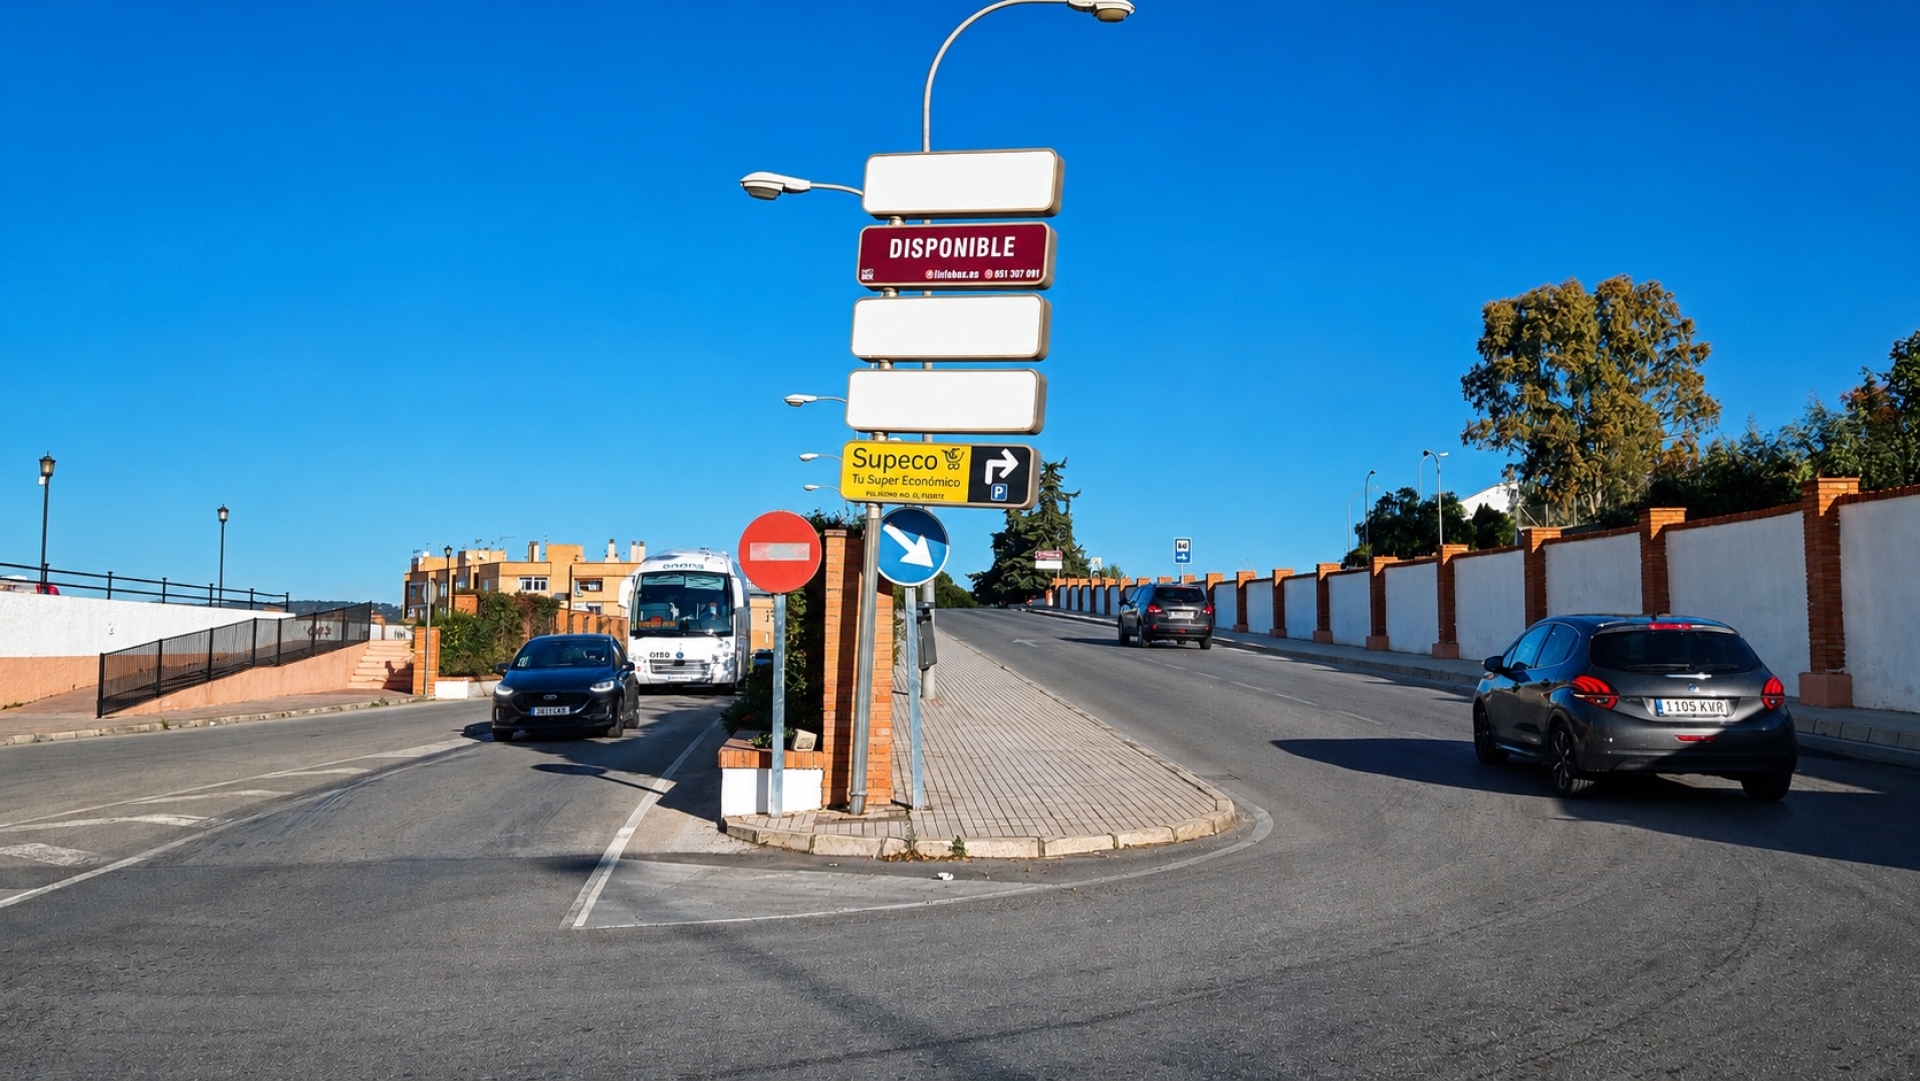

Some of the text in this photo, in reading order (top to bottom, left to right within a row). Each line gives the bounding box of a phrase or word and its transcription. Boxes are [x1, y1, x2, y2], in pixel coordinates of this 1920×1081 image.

[889, 236, 1016, 259] DISPONIBLE
[1010, 269, 1025, 279] 307
[852, 447, 938, 474] Supeco
[852, 474, 961, 488] Tu Super Económico
[1666, 701, 1724, 713] 1105 KVR
